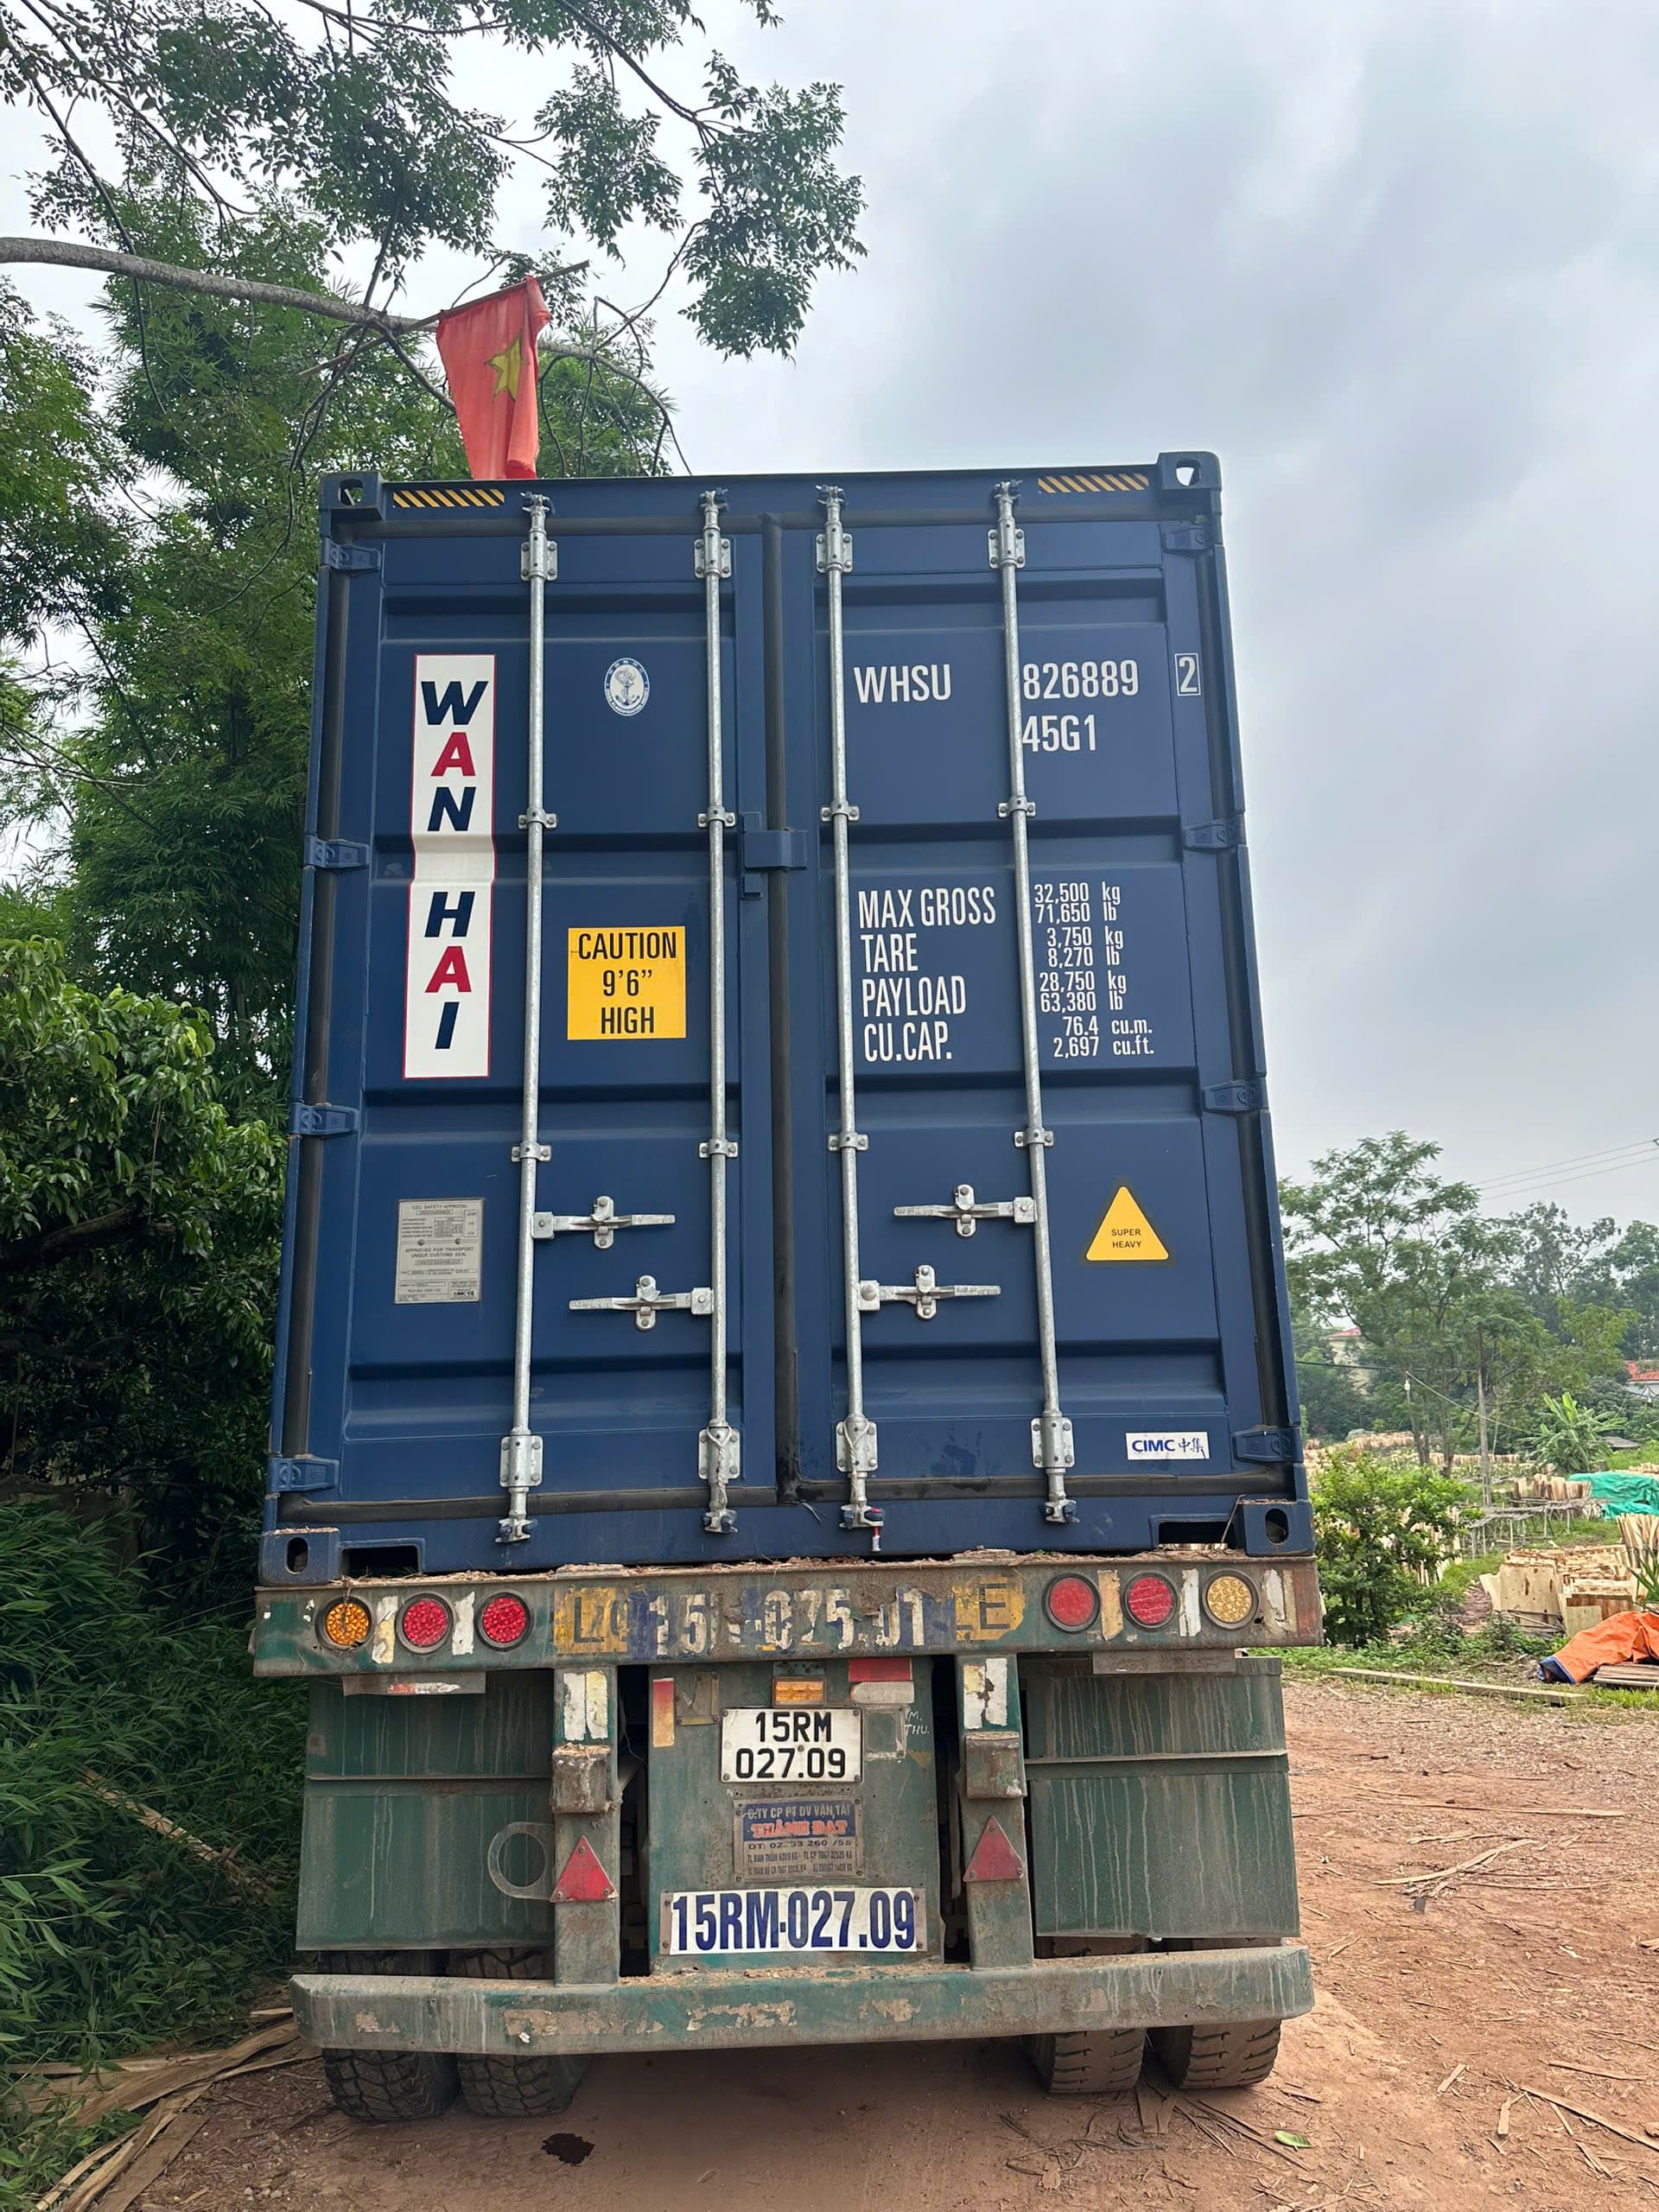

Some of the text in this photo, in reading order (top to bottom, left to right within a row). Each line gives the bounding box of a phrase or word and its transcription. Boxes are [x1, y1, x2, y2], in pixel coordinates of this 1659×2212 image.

[854, 656, 1198, 703] WHSU 826889 2
[1022, 715, 1097, 753] 45G1
[421, 680, 489, 832] WAN
[858, 886, 996, 929] MAX GROSS
[1034, 881, 1121, 906] 32,500 kg
[1035, 901, 1117, 925] 71,650 lb
[578, 932, 677, 961] CAUTION
[1047, 925, 1124, 950] 3,750 kg
[861, 933, 918, 973] TARE
[1048, 946, 1121, 969] 8,270 lb
[423, 891, 475, 1050] HAI
[1039, 970, 1127, 995] 28,750 kg
[862, 976, 967, 1017] PAYLOAD
[1040, 990, 1123, 1014] 63,380 lb
[601, 1007, 655, 1035] HIGH
[1063, 1015, 1154, 1036] 76.4 cu.m.
[864, 1020, 952, 1062] CU.CAP.
[1053, 1035, 1154, 1059] 2,697 cu.ft.
[1111, 1228, 1141, 1236] SUPER
[1132, 1439, 1176, 1452] CIMC
[755, 1712, 832, 1743] 15RM
[735, 1748, 846, 1779] 027.09
[799, 1804, 811, 1816] DV
